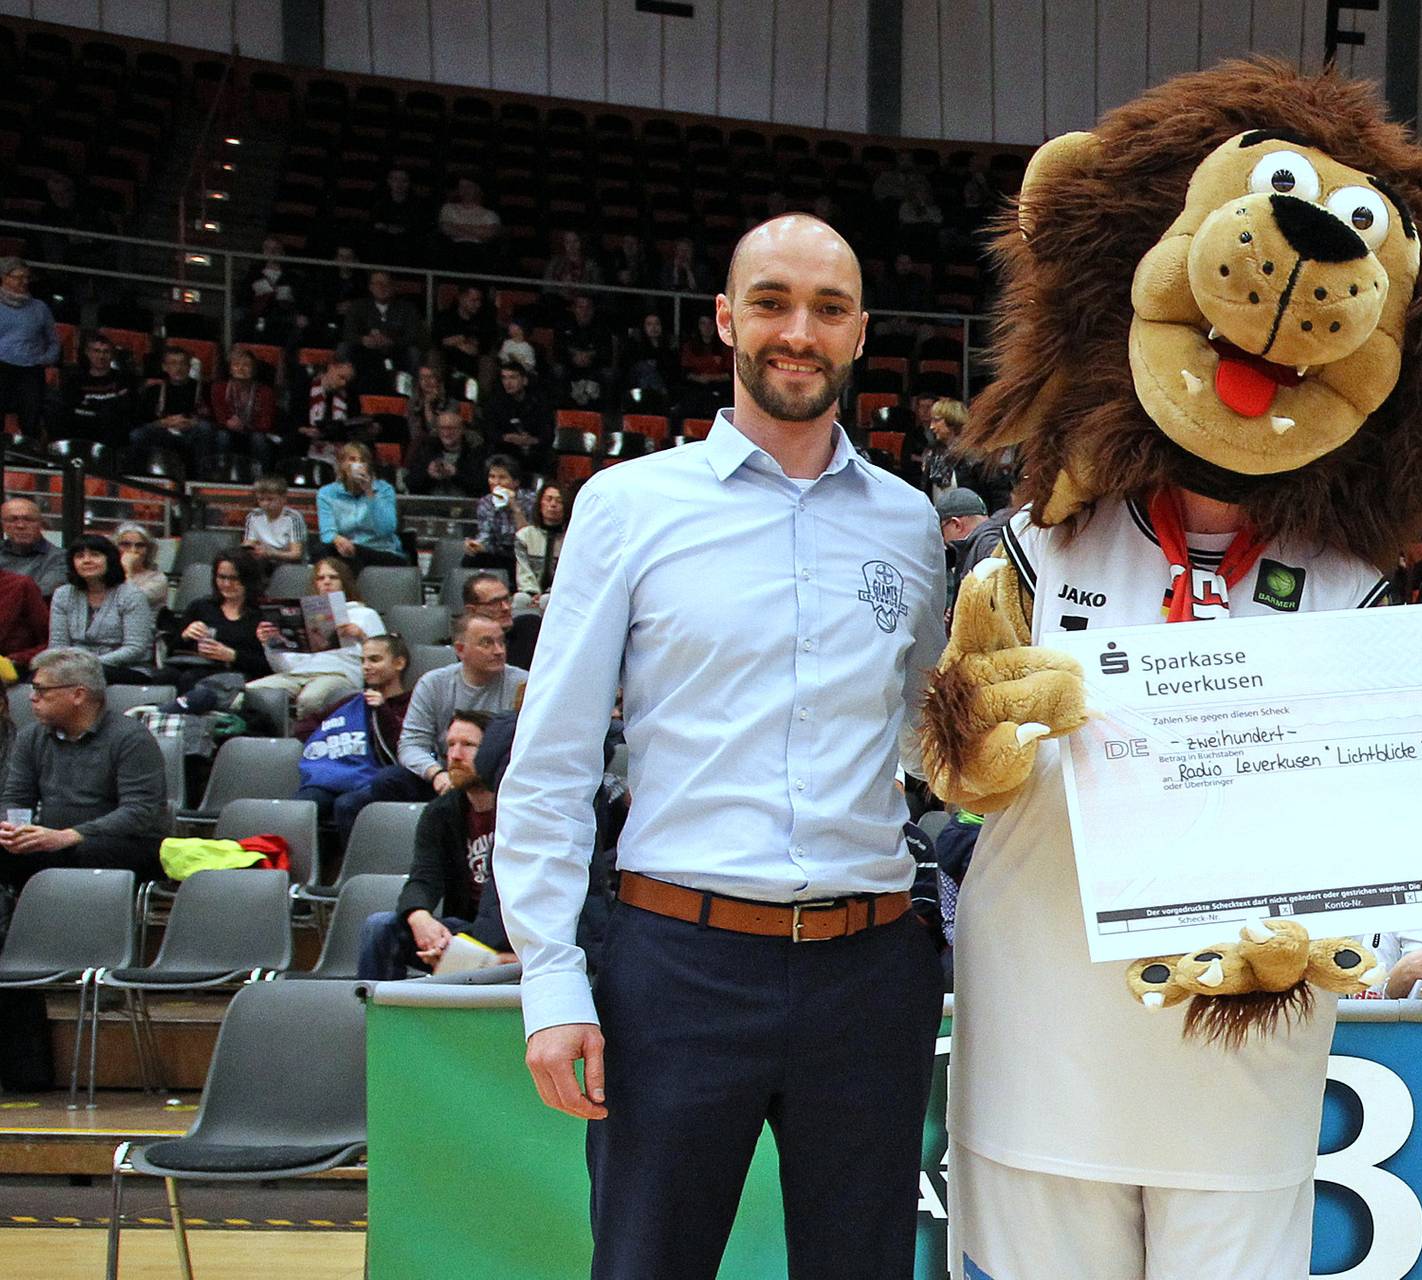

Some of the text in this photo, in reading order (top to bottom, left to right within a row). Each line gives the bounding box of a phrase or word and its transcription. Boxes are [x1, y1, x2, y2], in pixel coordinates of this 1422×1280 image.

[873, 579, 898, 606] GIANTS
[1058, 584, 1107, 608] JAKO
[1258, 592, 1297, 609] BARMER
[1141, 651, 1247, 675] Sparkasse
[1145, 674, 1264, 697] Leverkusen
[1152, 706, 1290, 726] Zahlen Sie gegen diesen Scheck
[1104, 738, 1149, 760] DE
[1159, 755, 1187, 763] Betrag
[1198, 750, 1245, 760] Buchstaben
[1178, 760, 1222, 782] Radio
[1236, 753, 1321, 774] Leverkusen
[1163, 778, 1235, 791] oder Überbringer
[1146, 909, 1160, 917] Der
[1160, 904, 1211, 915] vorgedruckte
[1211, 899, 1252, 910] Schecktext
[1252, 897, 1268, 906] darf
[1269, 896, 1288, 905] nicht
[1288, 892, 1322, 903] geändert
[1322, 890, 1340, 899] oder
[1341, 887, 1378, 898] gestrichen
[1378, 885, 1407, 893] werden.
[1408, 883, 1421, 891] Die
[1324, 899, 1364, 910] Konto-Nr.
